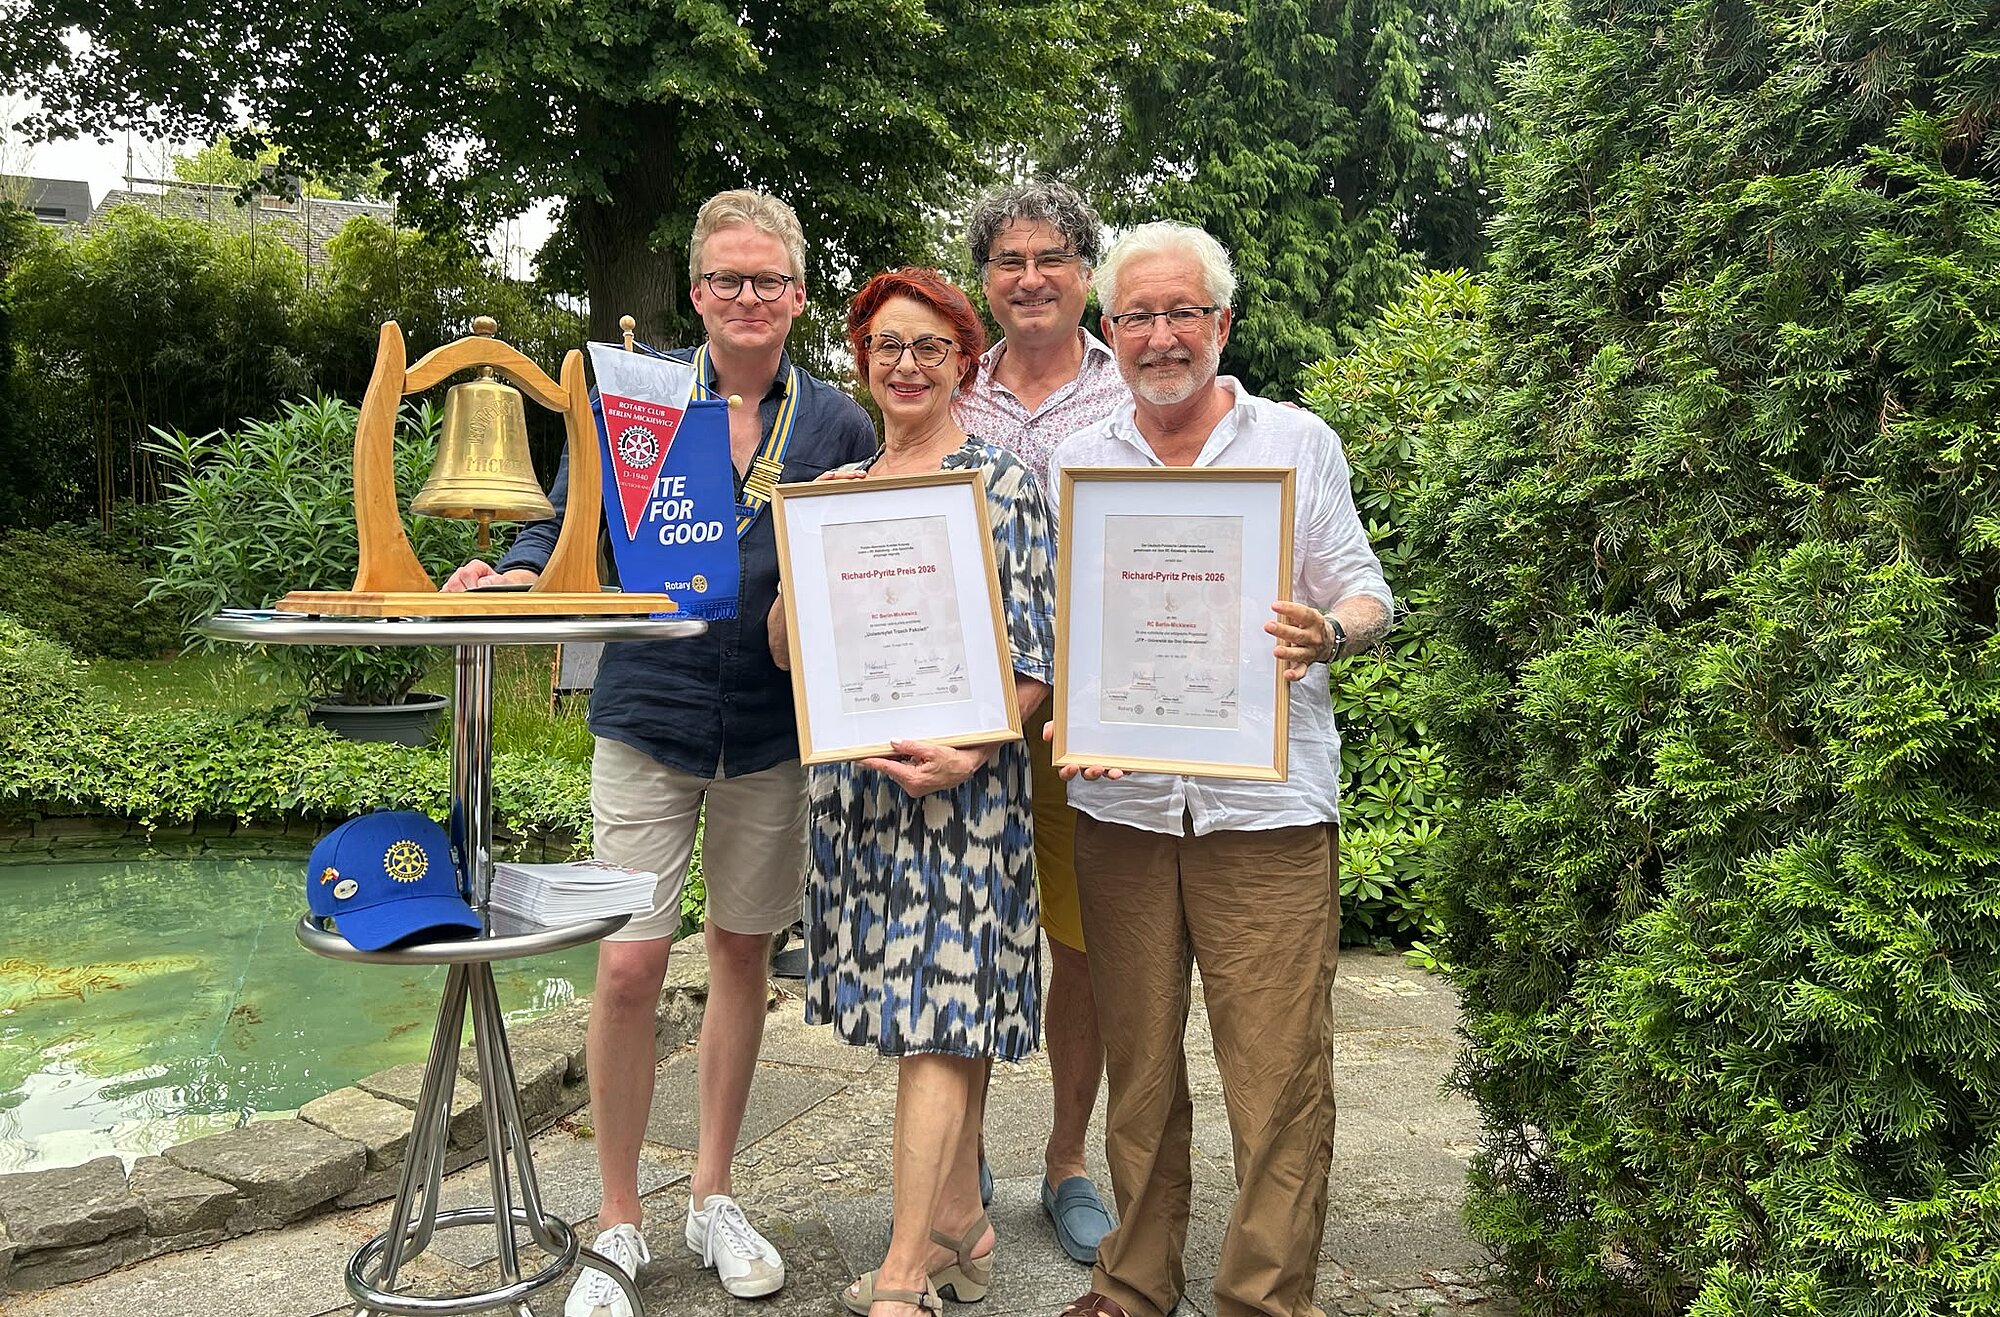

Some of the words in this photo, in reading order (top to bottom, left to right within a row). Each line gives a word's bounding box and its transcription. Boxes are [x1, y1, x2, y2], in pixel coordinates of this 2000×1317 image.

[618, 402, 646, 413] ROTARY
[648, 408, 666, 416] CLUB
[608, 408, 632, 418] BERLIN
[633, 414, 674, 427] MICKIEWICZ
[623, 470, 648, 480] D-1940
[652, 476, 686, 498] ITE
[649, 500, 694, 522] FOR
[659, 522, 724, 545] GOOD
[841, 568, 895, 581] Richard-Pyritz
[897, 567, 916, 576] Preis
[918, 565, 936, 574] 2026
[1122, 571, 1179, 582] Richard-Pyritz
[1181, 572, 1203, 581] Preis
[1205, 573, 1225, 581] 2026
[665, 581, 691, 591] Rotary
